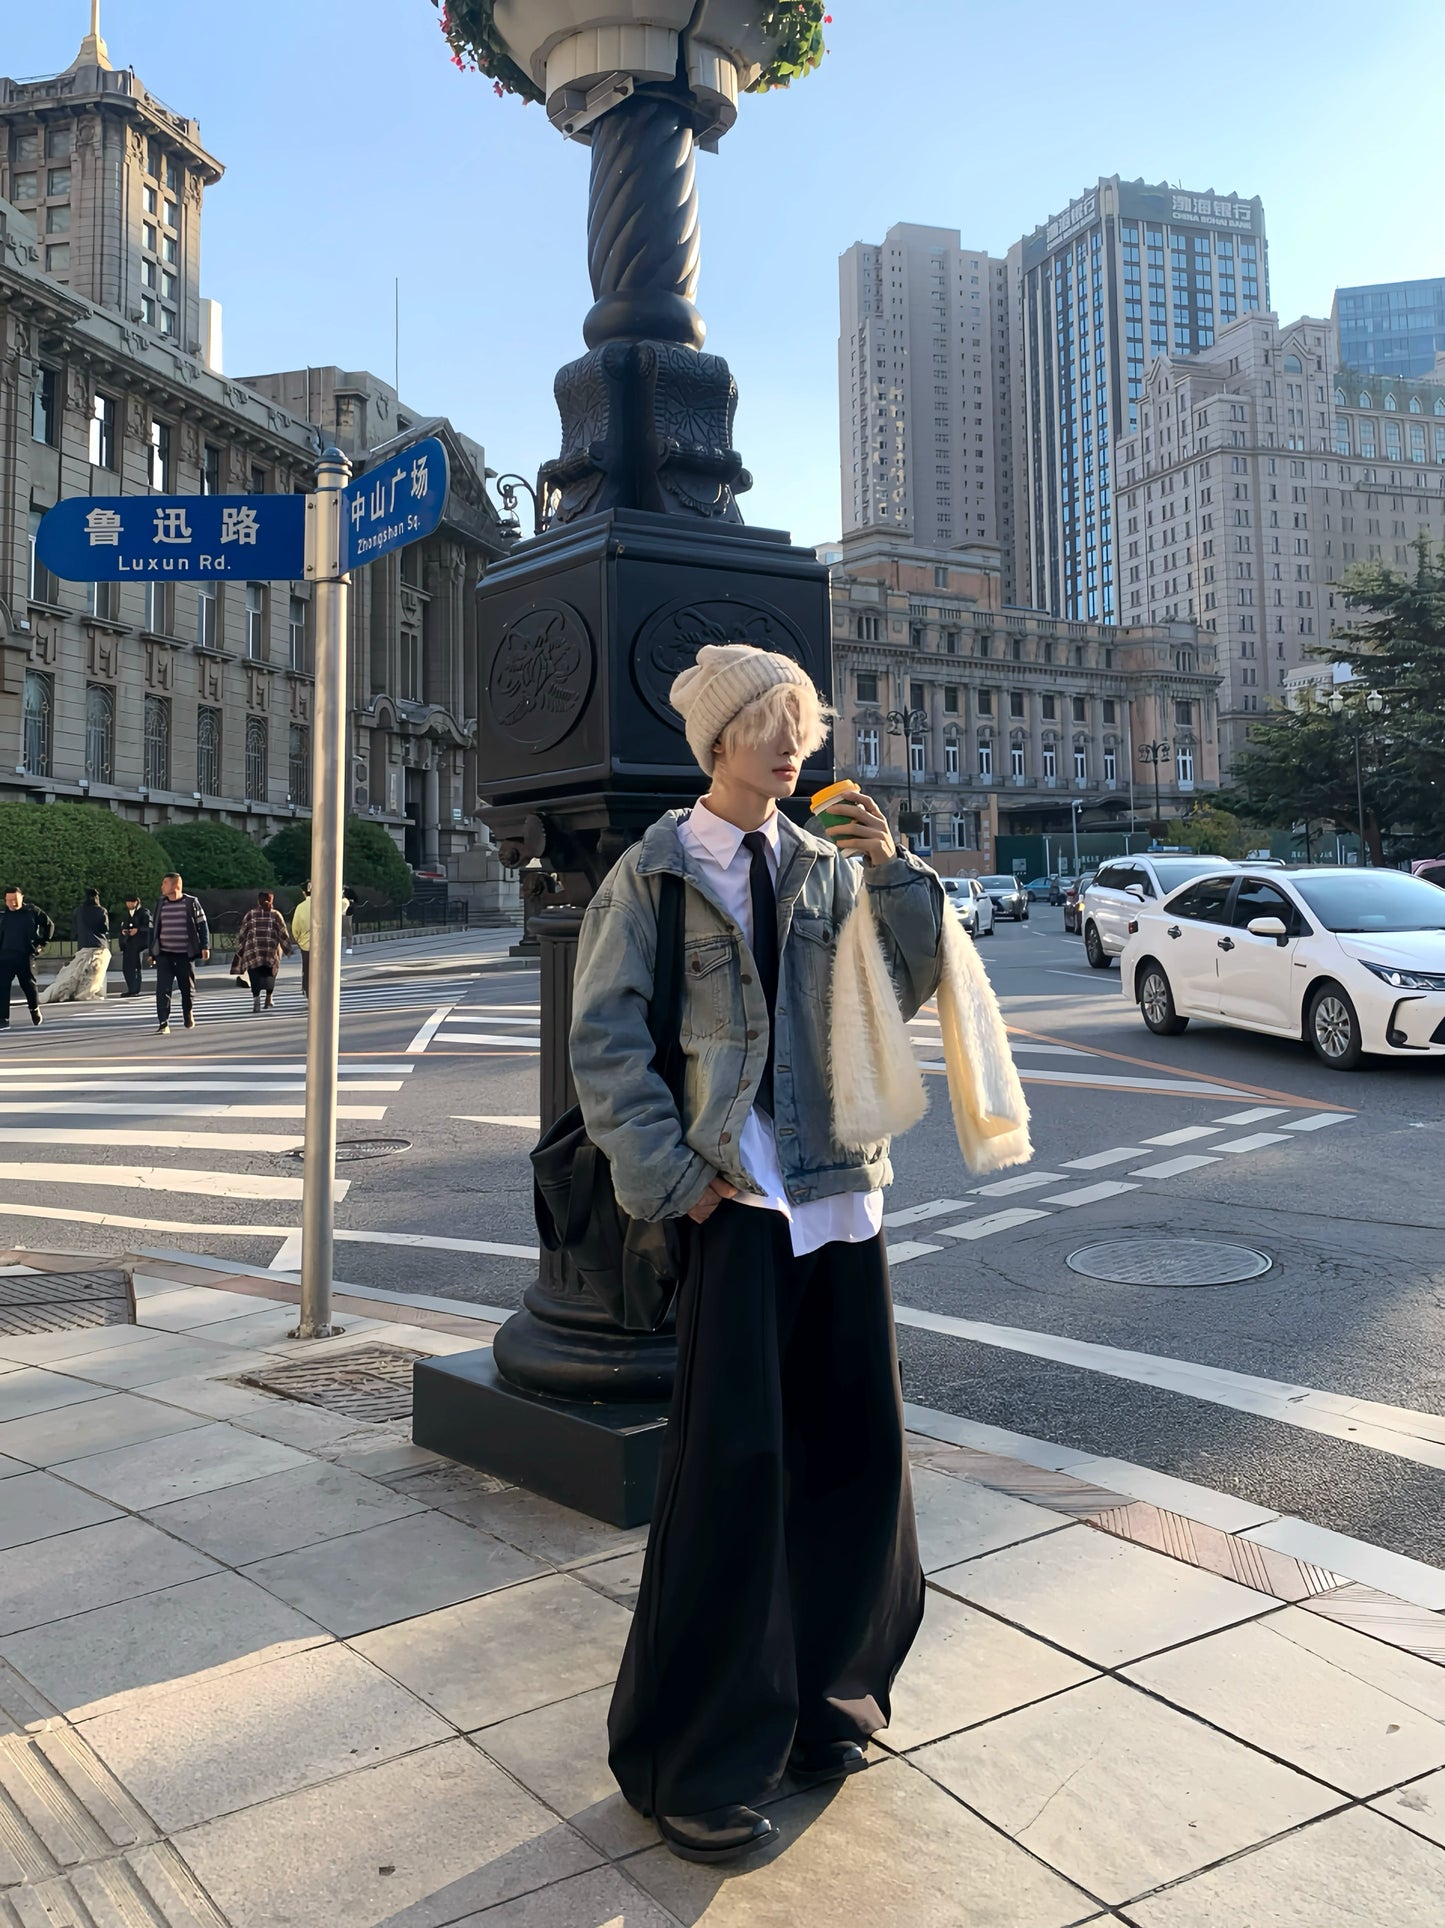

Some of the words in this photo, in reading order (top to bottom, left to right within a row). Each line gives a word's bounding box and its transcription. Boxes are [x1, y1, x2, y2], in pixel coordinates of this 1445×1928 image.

[351, 455, 428, 532] 中山广场
[84, 506, 260, 546] 鲁迅路
[357, 522, 404, 554] Zhongshan
[407, 514, 421, 531] Sq.
[118, 555, 189, 571] Luxun
[199, 554, 231, 570] Rd.
